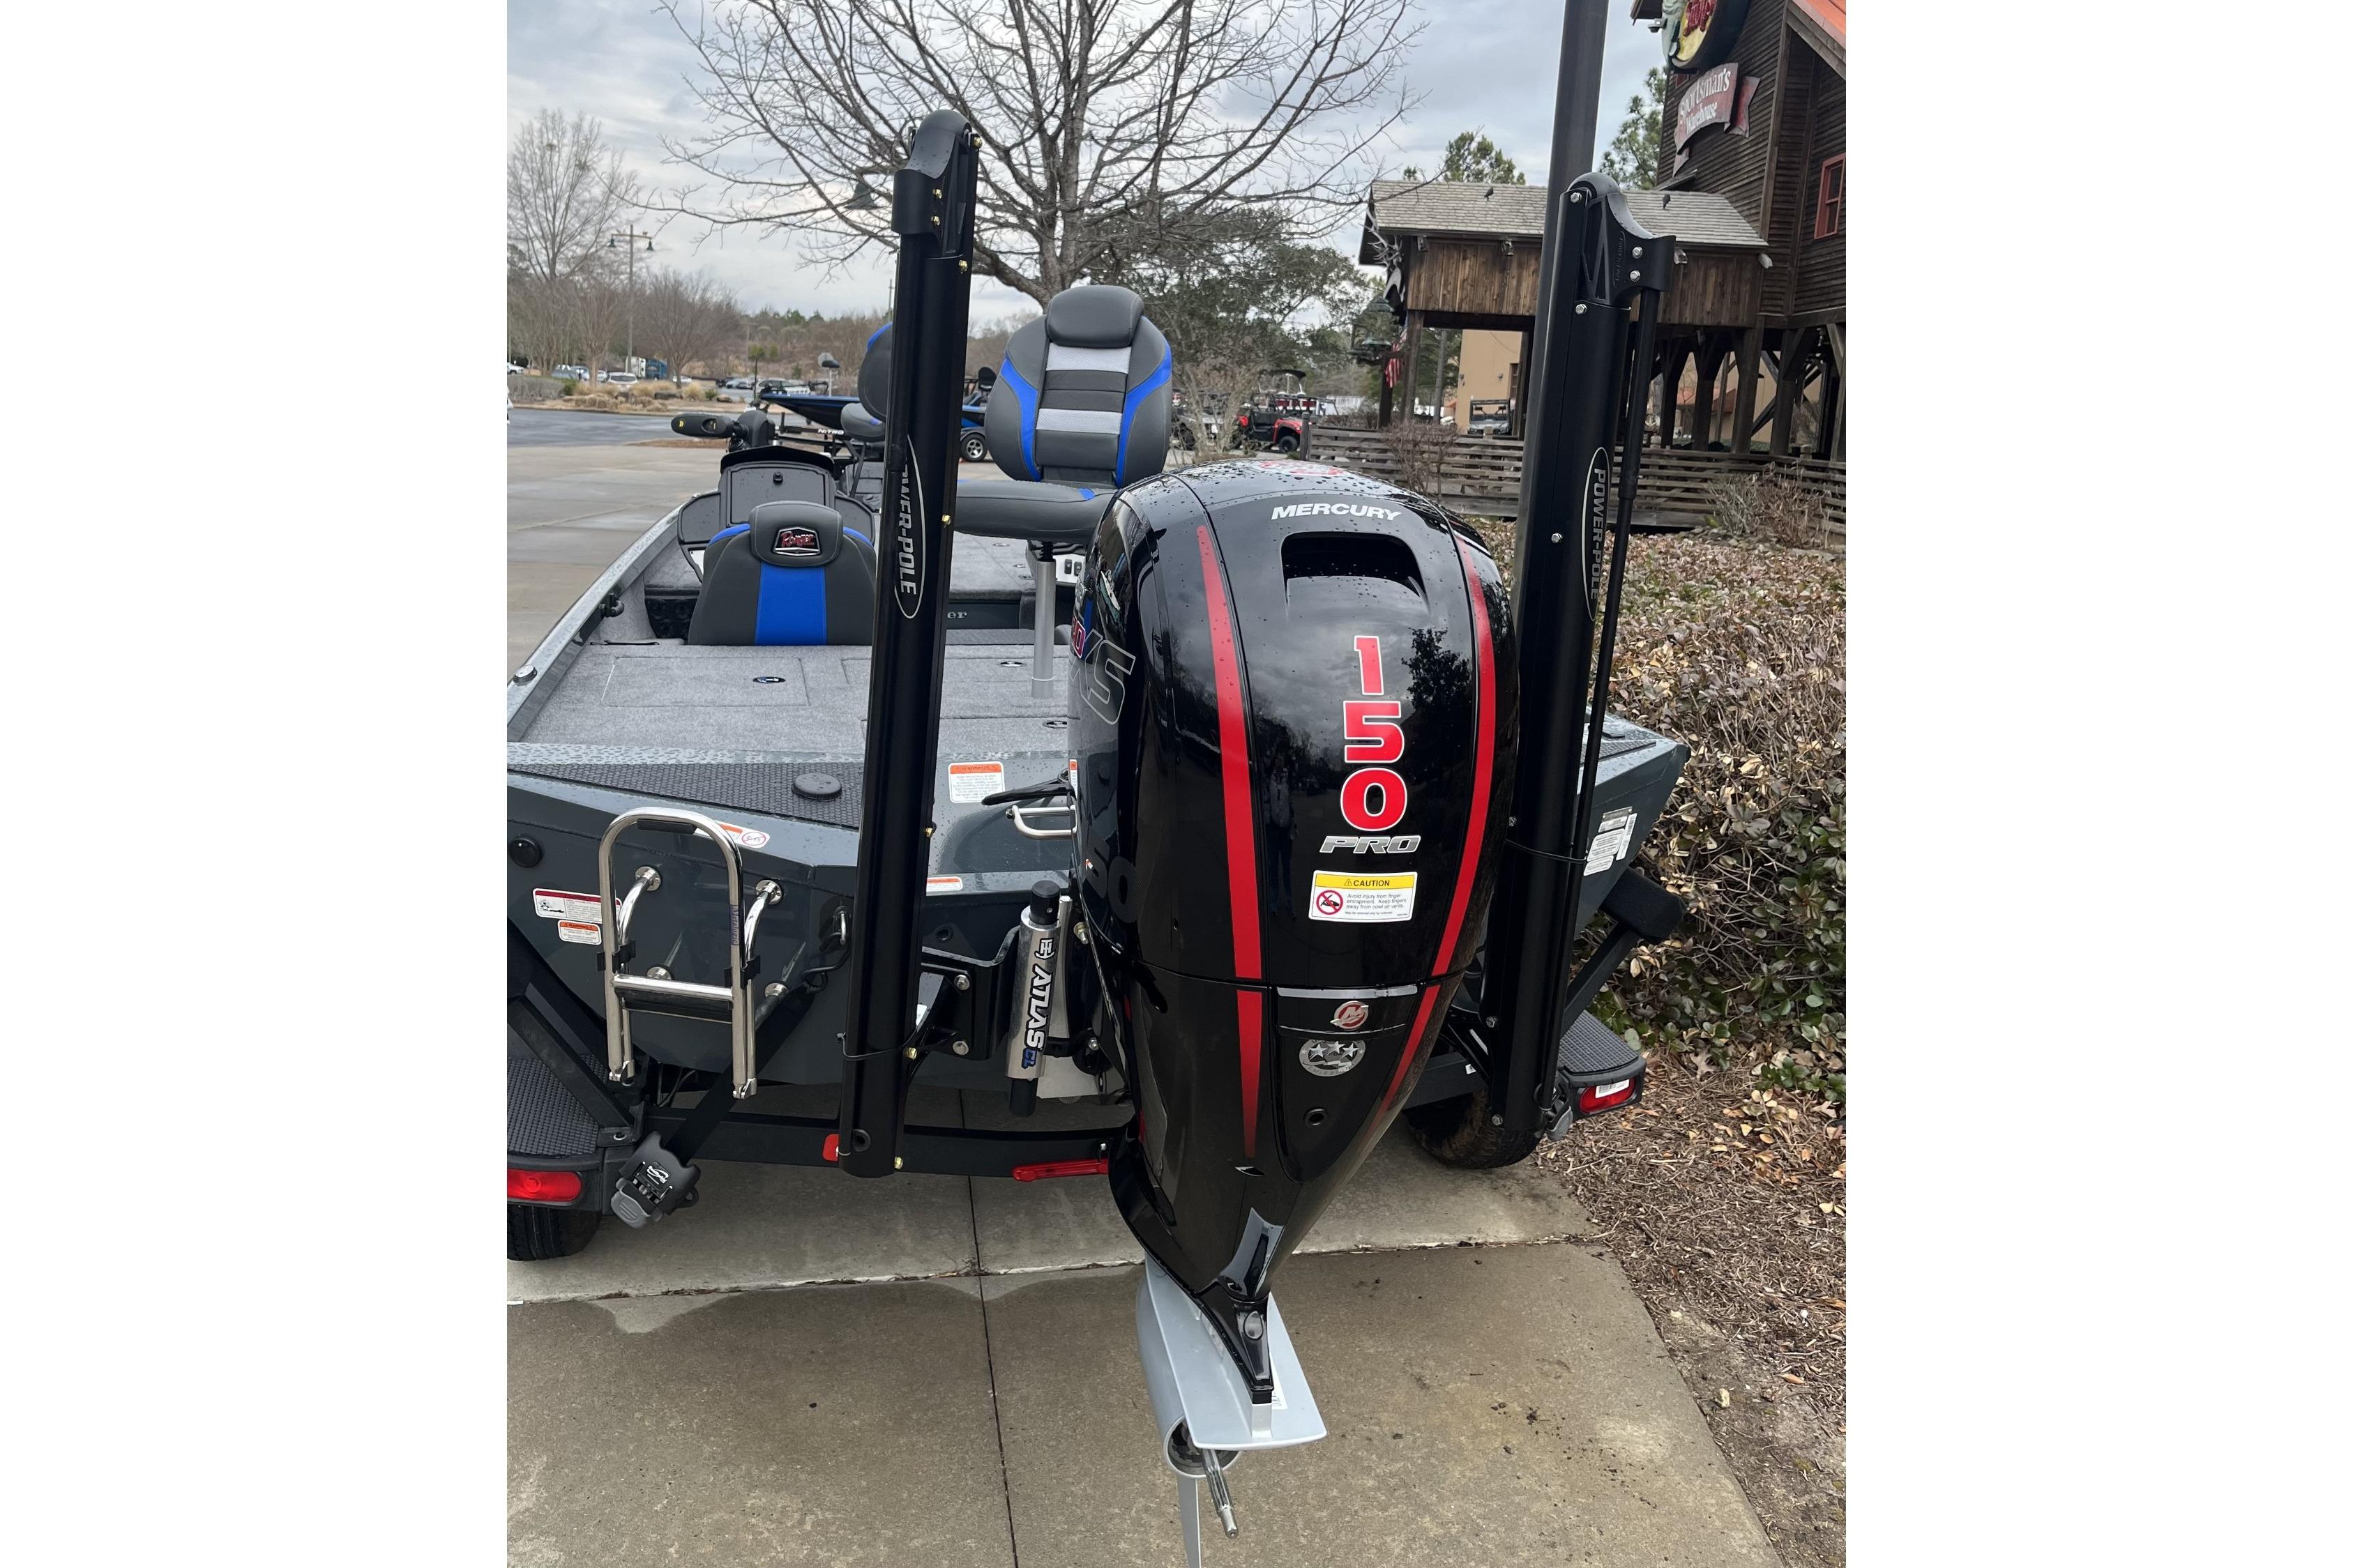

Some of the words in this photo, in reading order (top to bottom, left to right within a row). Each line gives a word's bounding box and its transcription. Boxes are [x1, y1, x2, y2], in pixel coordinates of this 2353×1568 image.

[1679, 68, 1731, 123] Sportsman's
[1271, 503, 1402, 521] MERCURY
[1591, 468, 1606, 600] POWER-POLE
[1340, 635, 1408, 832] 150
[1319, 835, 1421, 854] PRO
[1026, 964, 1053, 1049] ATLAS
